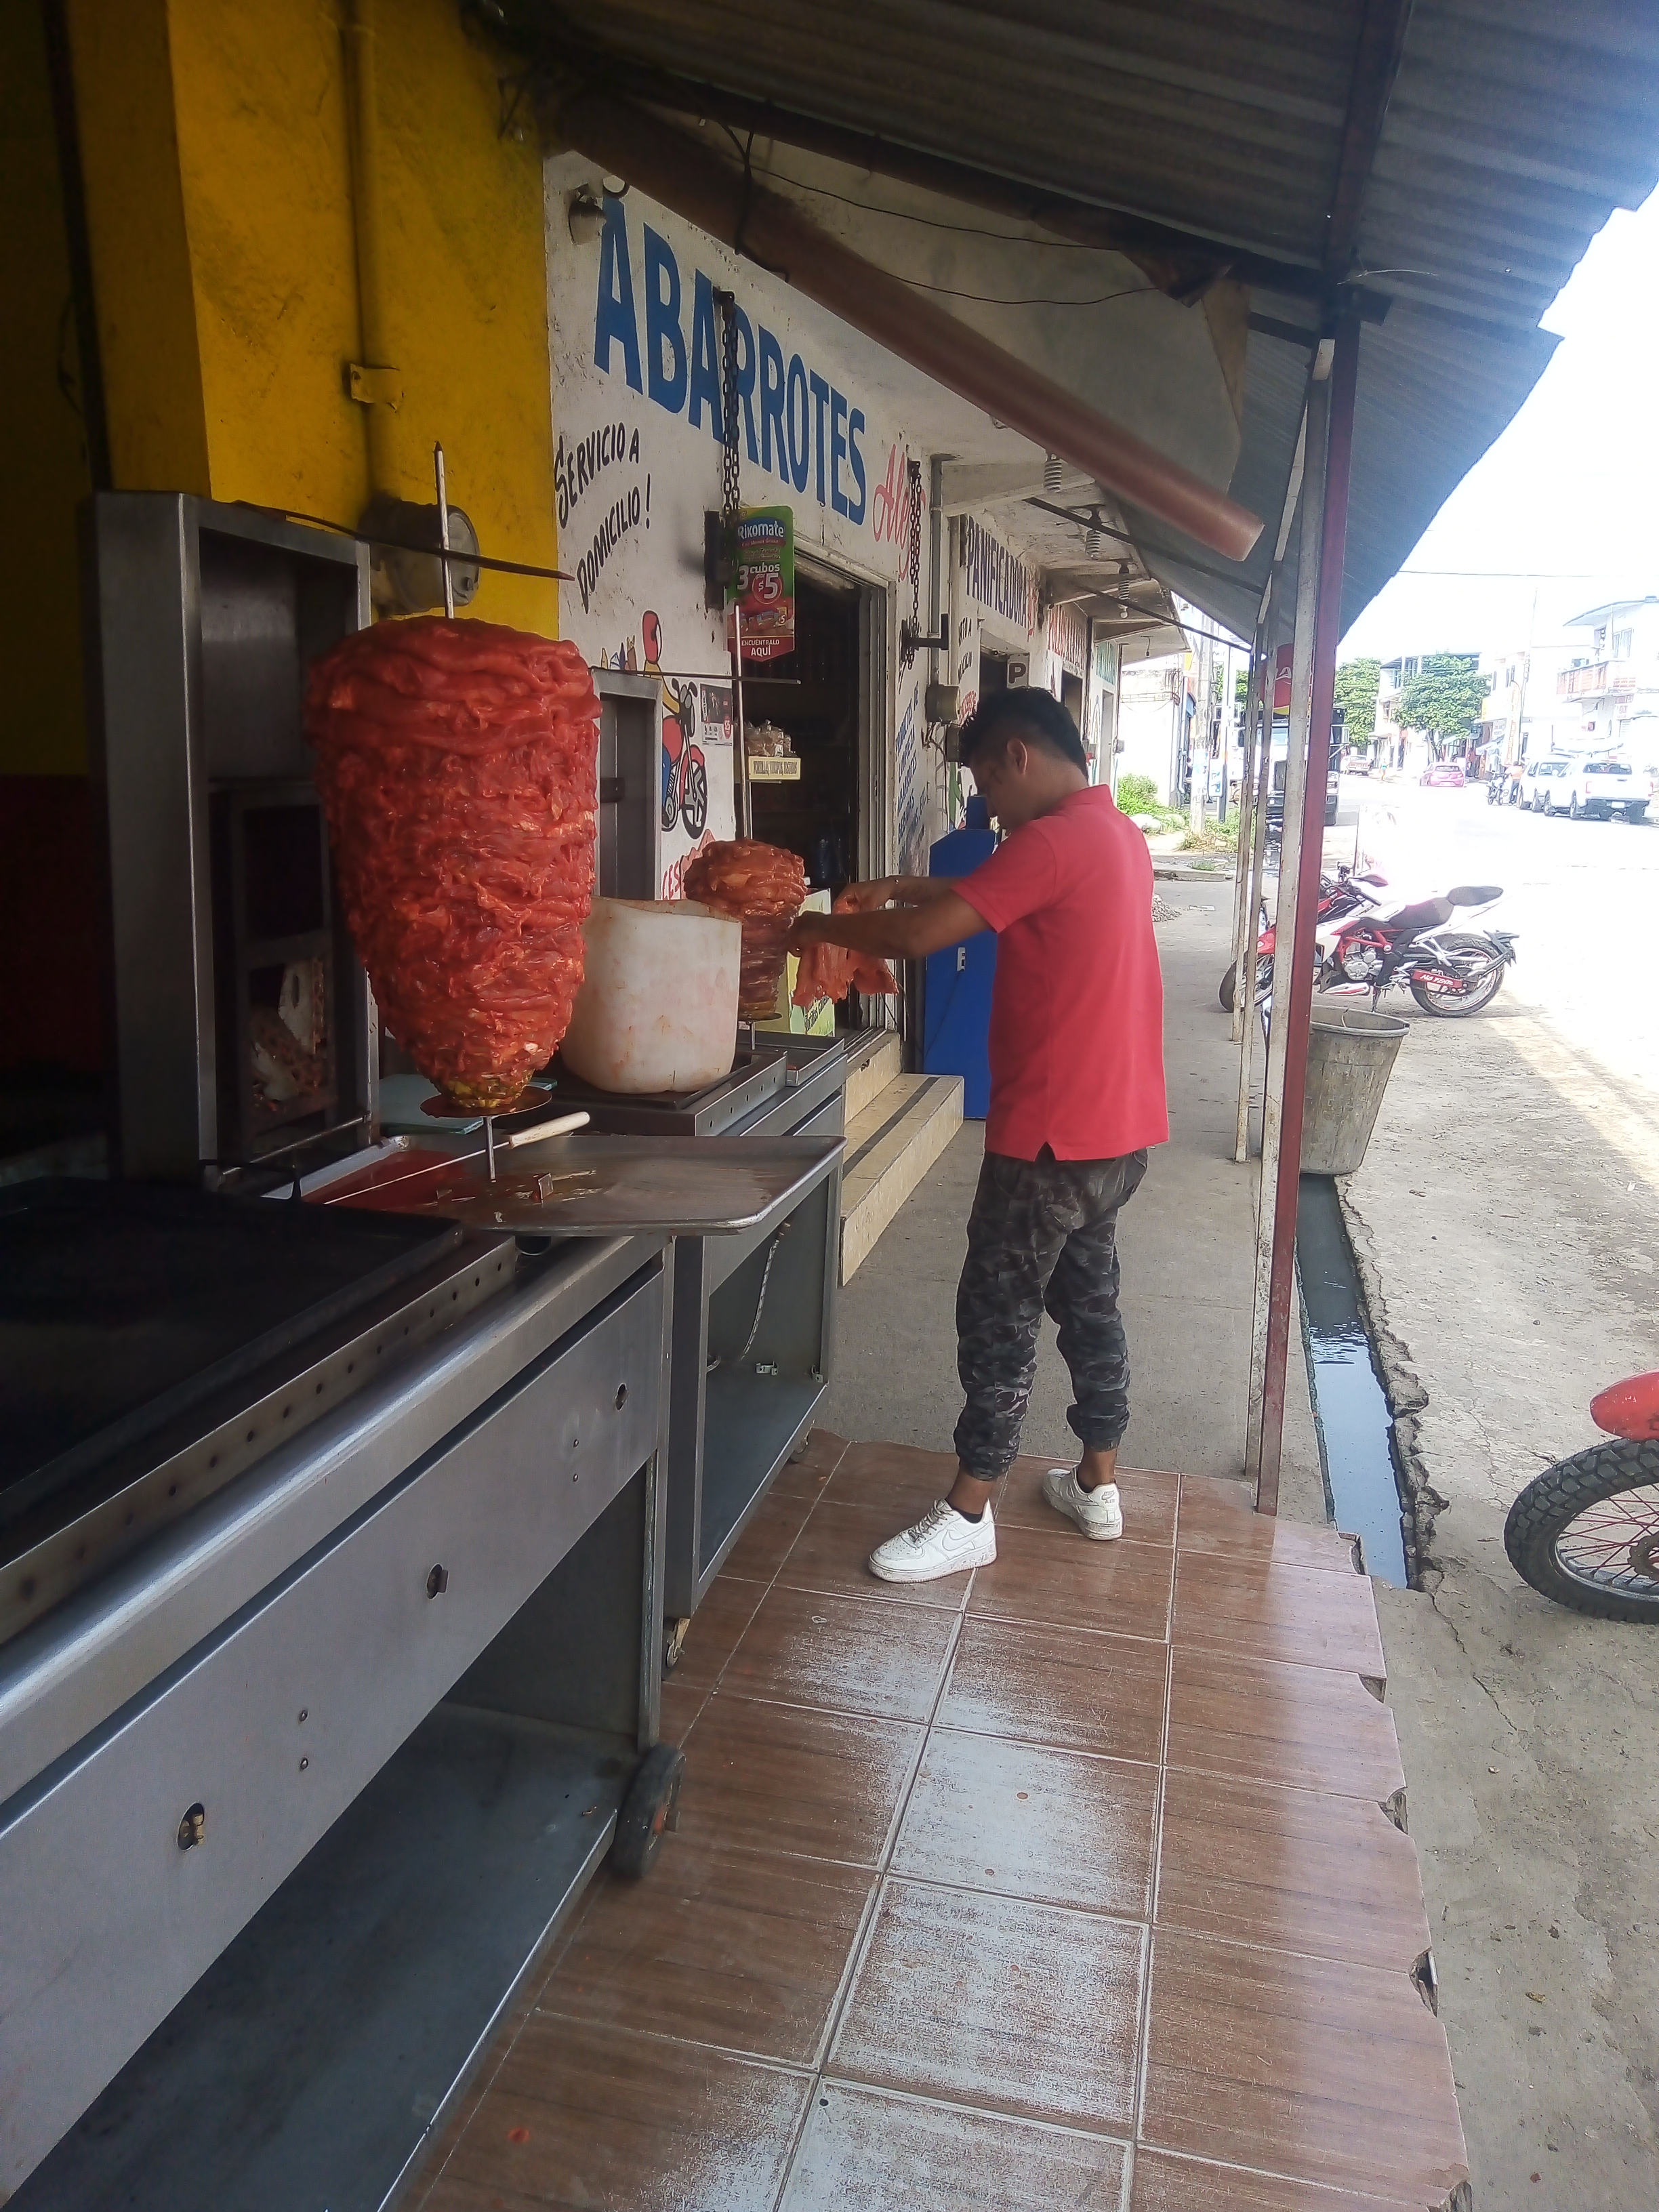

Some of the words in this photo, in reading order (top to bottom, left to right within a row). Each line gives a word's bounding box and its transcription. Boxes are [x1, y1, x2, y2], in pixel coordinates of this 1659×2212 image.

[594, 194, 866, 526] ABARROTES
[554, 422, 626, 529] SERVICIO
[629, 428, 639, 464] A
[737, 520, 784, 539] Rikomate
[737, 565, 749, 590] 3
[750, 562, 780, 574] cubos
[758, 572, 779, 599] $5
[966, 515, 1027, 629] PANIFICADORA
[750, 644, 771, 657] AQUÍ
[1008, 662, 1027, 684] P
